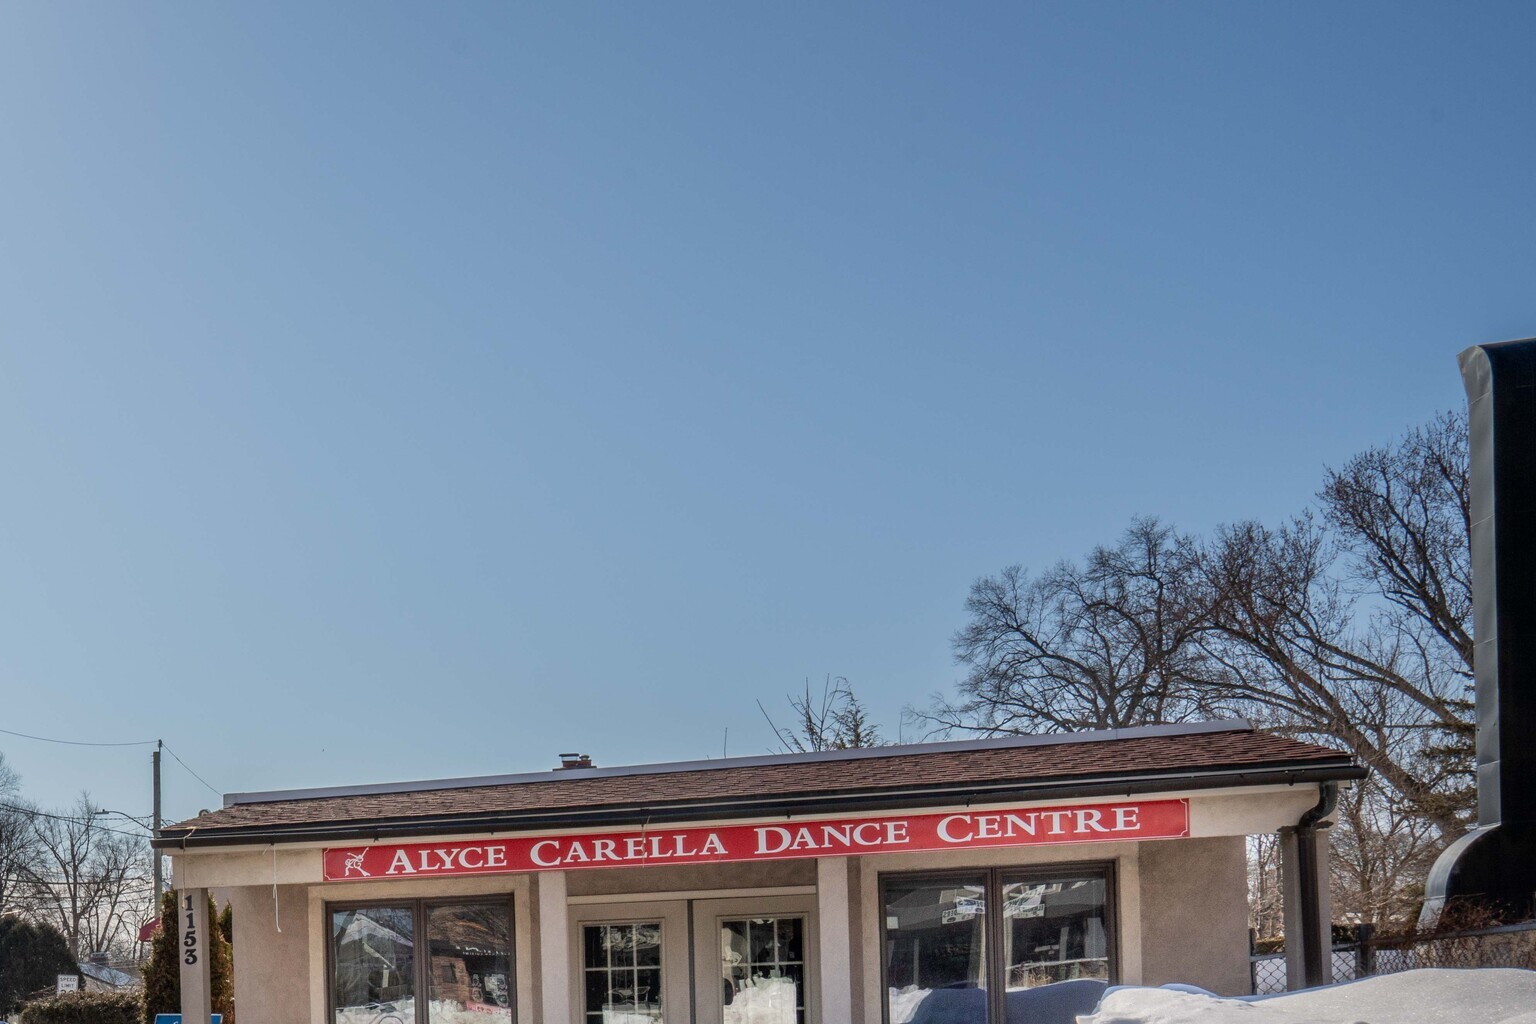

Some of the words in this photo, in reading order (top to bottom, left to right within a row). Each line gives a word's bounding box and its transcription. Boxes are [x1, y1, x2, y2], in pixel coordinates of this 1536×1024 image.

[385, 845, 507, 874] ALYCE
[529, 833, 728, 867] CARELLA
[753, 821, 910, 854] DANCE
[936, 806, 1141, 842] CENTRE
[184, 894, 198, 966] 1153
